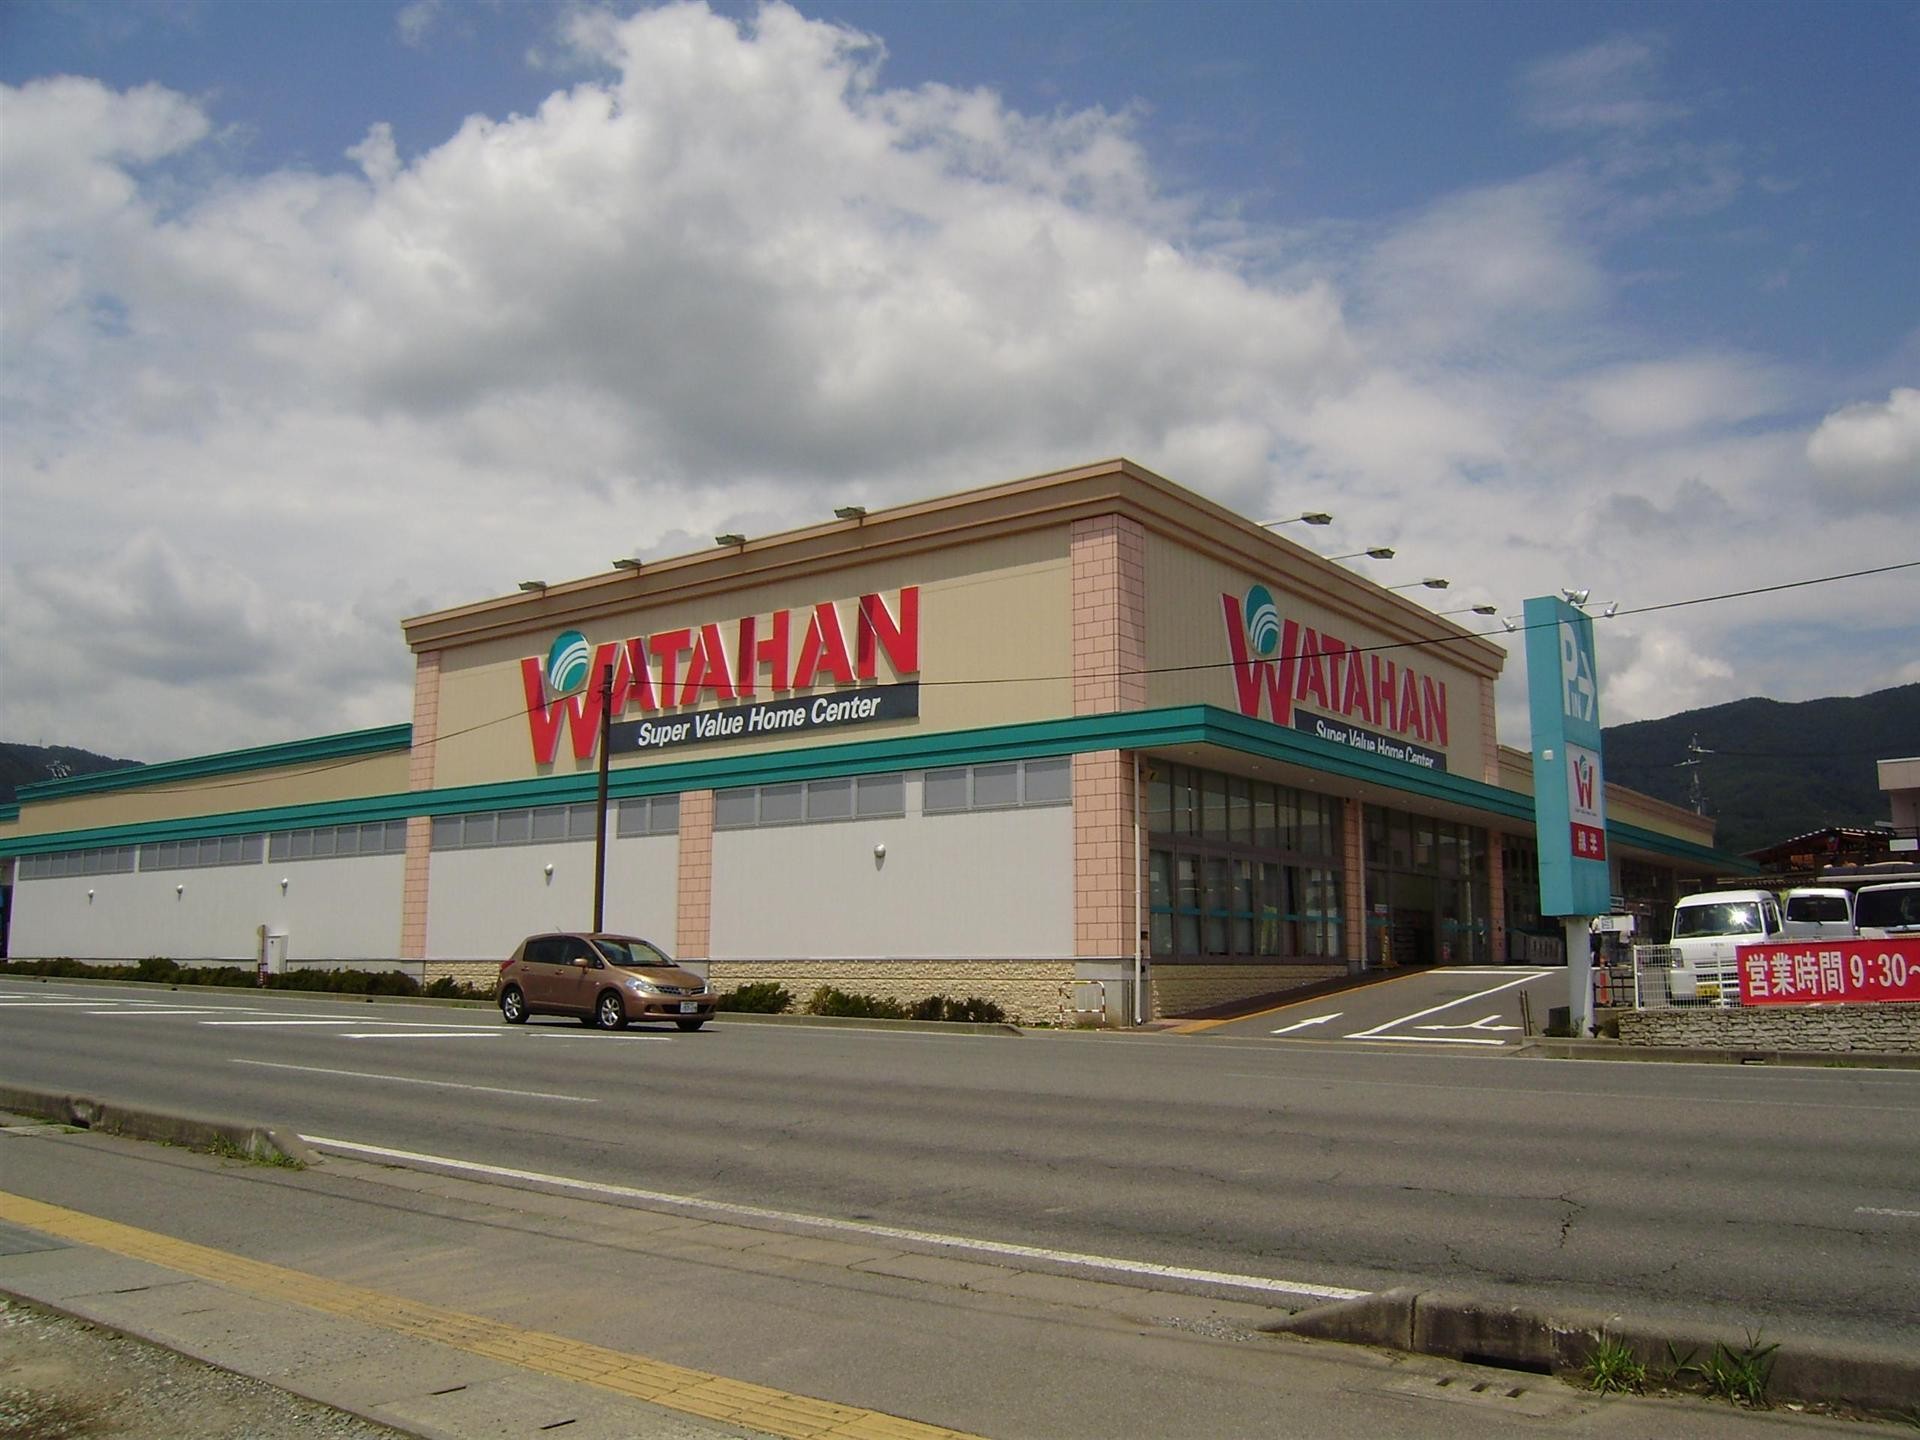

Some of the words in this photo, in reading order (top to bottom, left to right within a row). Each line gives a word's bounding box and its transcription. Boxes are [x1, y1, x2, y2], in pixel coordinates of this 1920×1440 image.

[521, 586, 920, 764] WATAHAN
[1221, 592, 1449, 747] WATAHAN
[638, 722, 690, 747] Super
[695, 712, 743, 738] Value
[748, 706, 805, 732] Home
[811, 696, 881, 724] Center
[1349, 728, 1376, 751] Value
[1377, 737, 1405, 760] Home
[1405, 745, 1434, 768] Center
[1745, 951, 1845, 997] 営業時間
